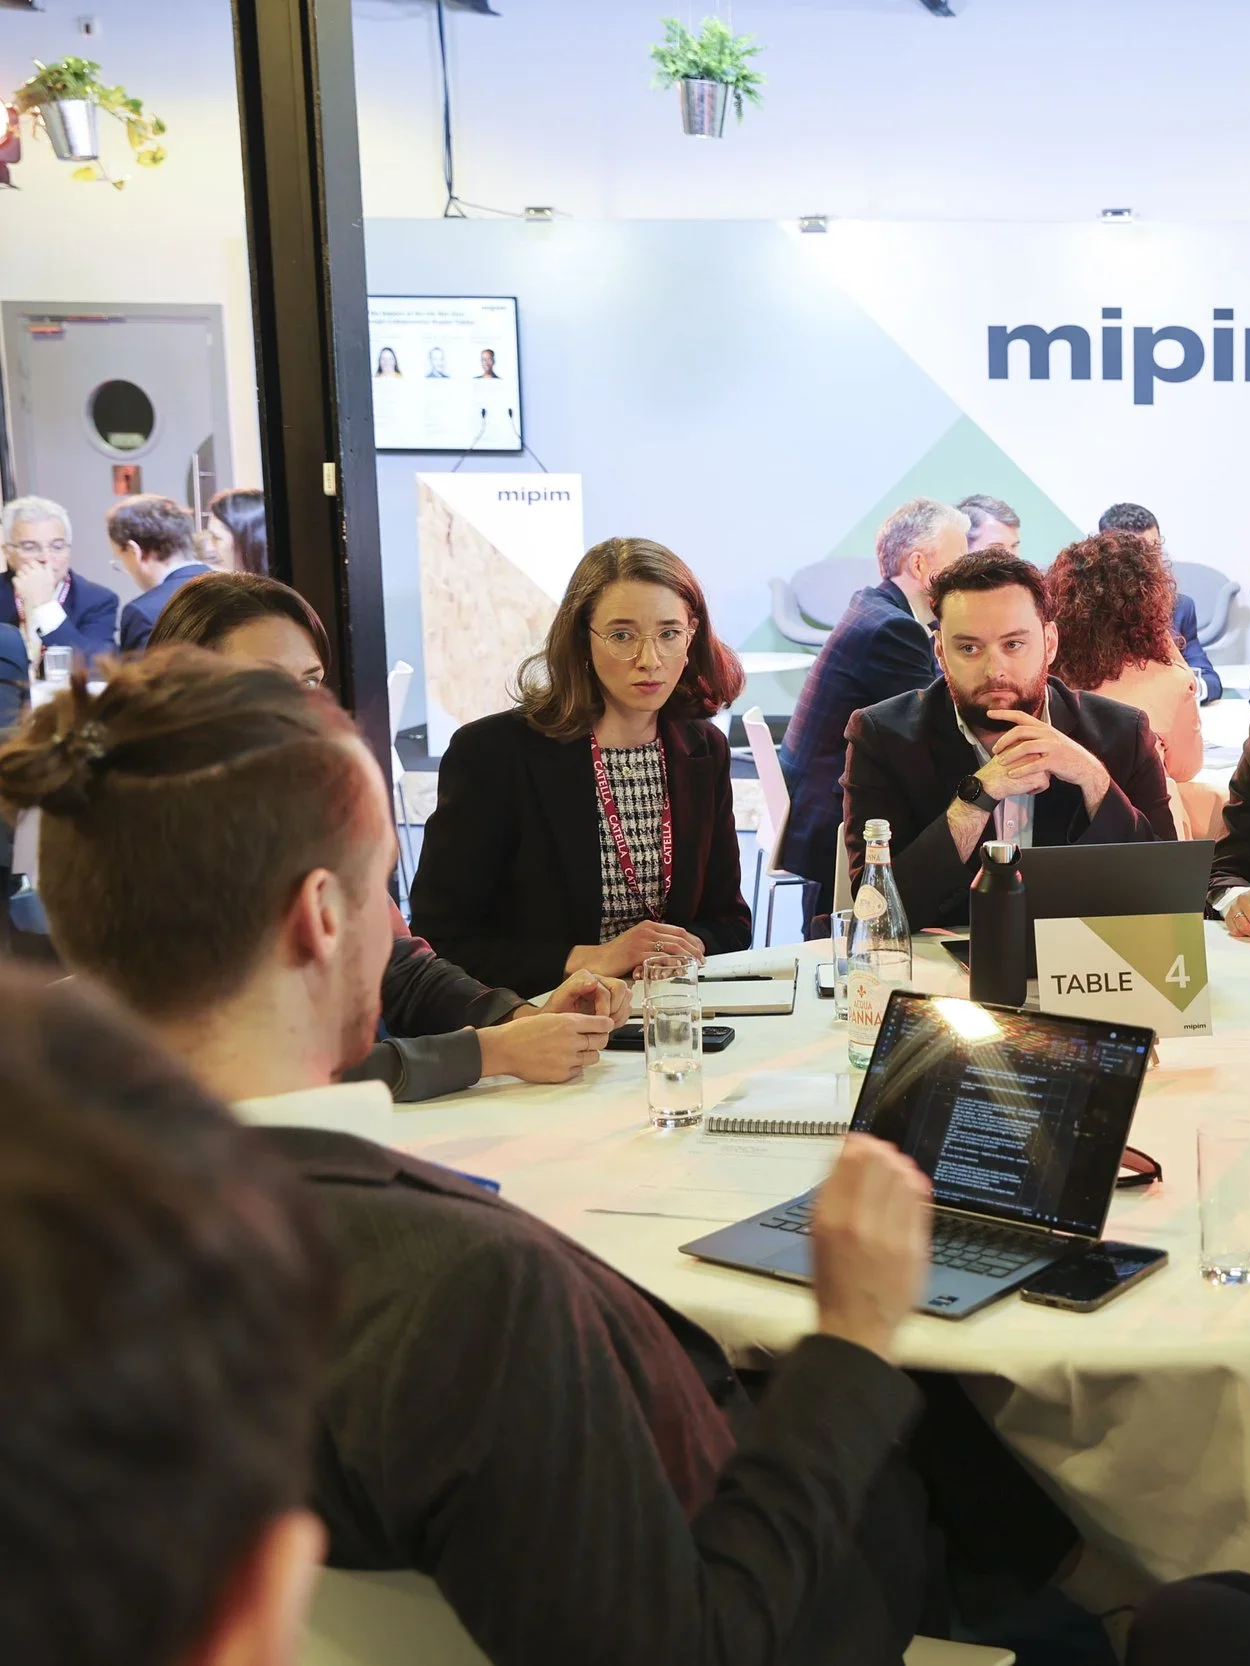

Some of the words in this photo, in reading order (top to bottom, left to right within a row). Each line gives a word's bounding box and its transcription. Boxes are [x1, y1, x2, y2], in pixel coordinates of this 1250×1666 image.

[498, 486, 571, 506] mipim
[593, 760, 612, 805] CATELLA
[609, 814, 629, 858] CATELLA
[663, 820, 672, 865] CATELLA
[624, 867, 640, 894] CATE
[1051, 972, 1133, 995] TABLE
[1165, 954, 1191, 989] 4
[854, 1000, 872, 1010] ACQUA
[1183, 1022, 1207, 1031] mipim
